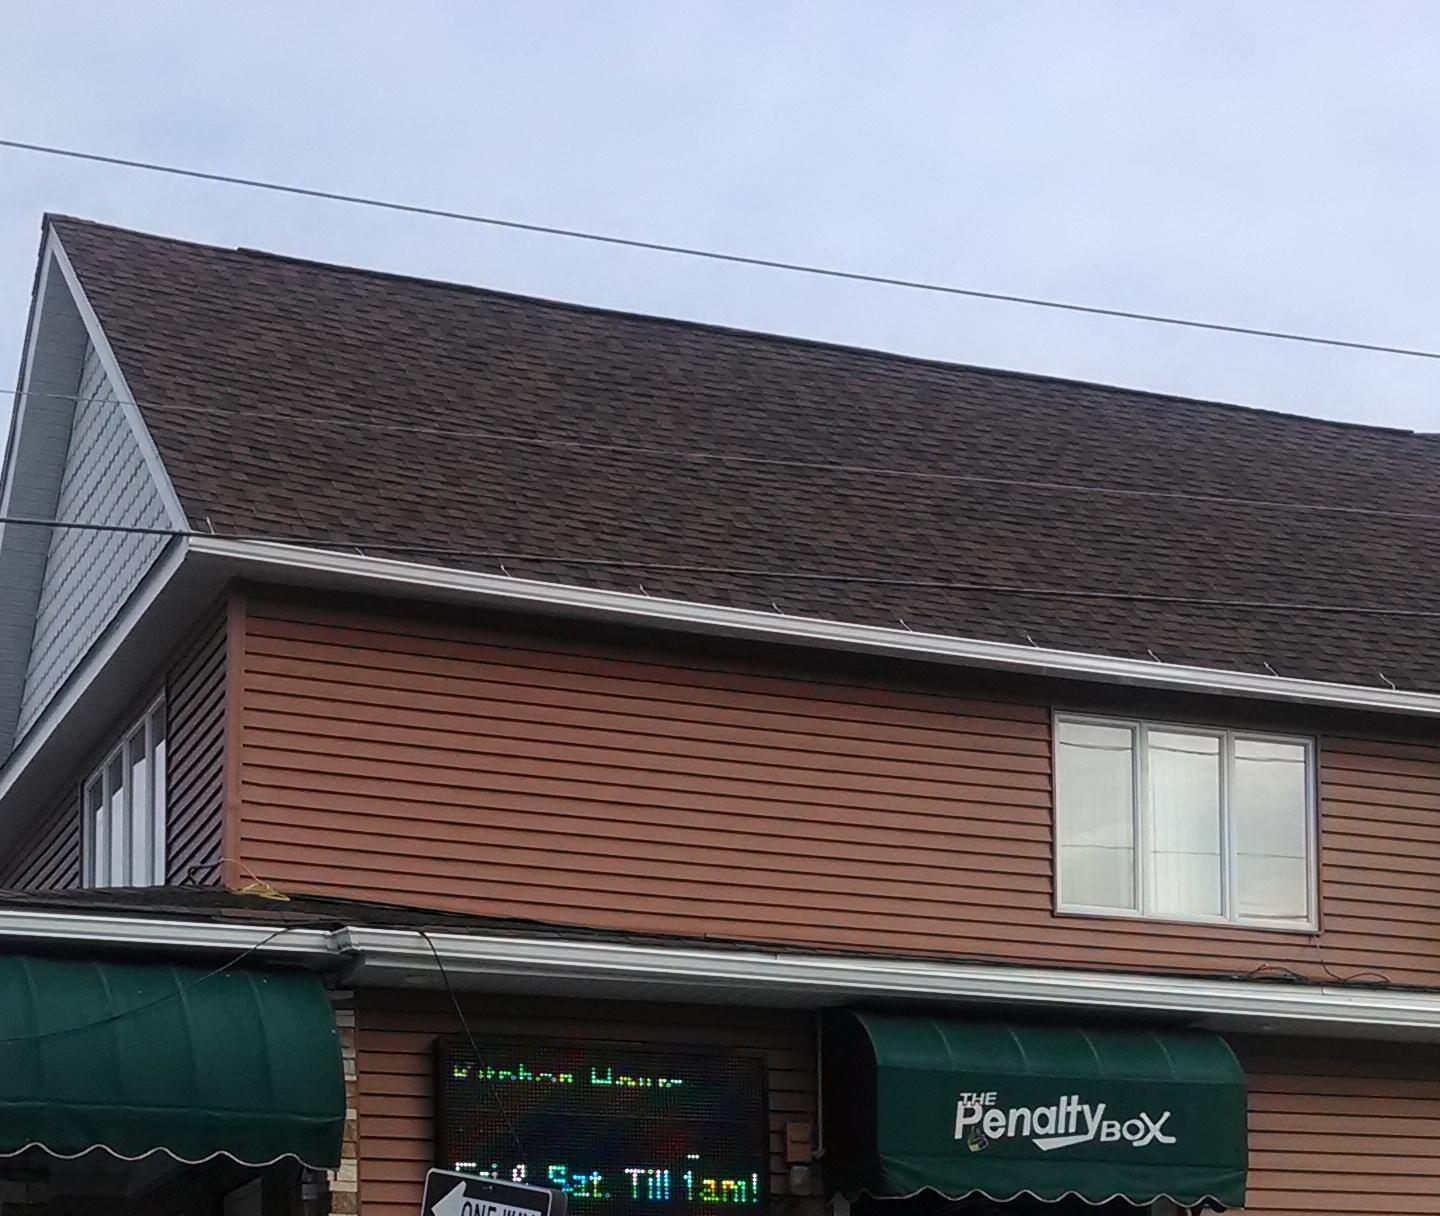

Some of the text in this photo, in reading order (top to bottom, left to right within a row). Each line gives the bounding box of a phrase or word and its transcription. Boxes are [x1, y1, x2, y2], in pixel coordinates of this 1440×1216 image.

[960, 1092, 998, 1106] THE
[954, 1095, 1177, 1150] Penalty BOX
[625, 1168, 670, 1200] Till
